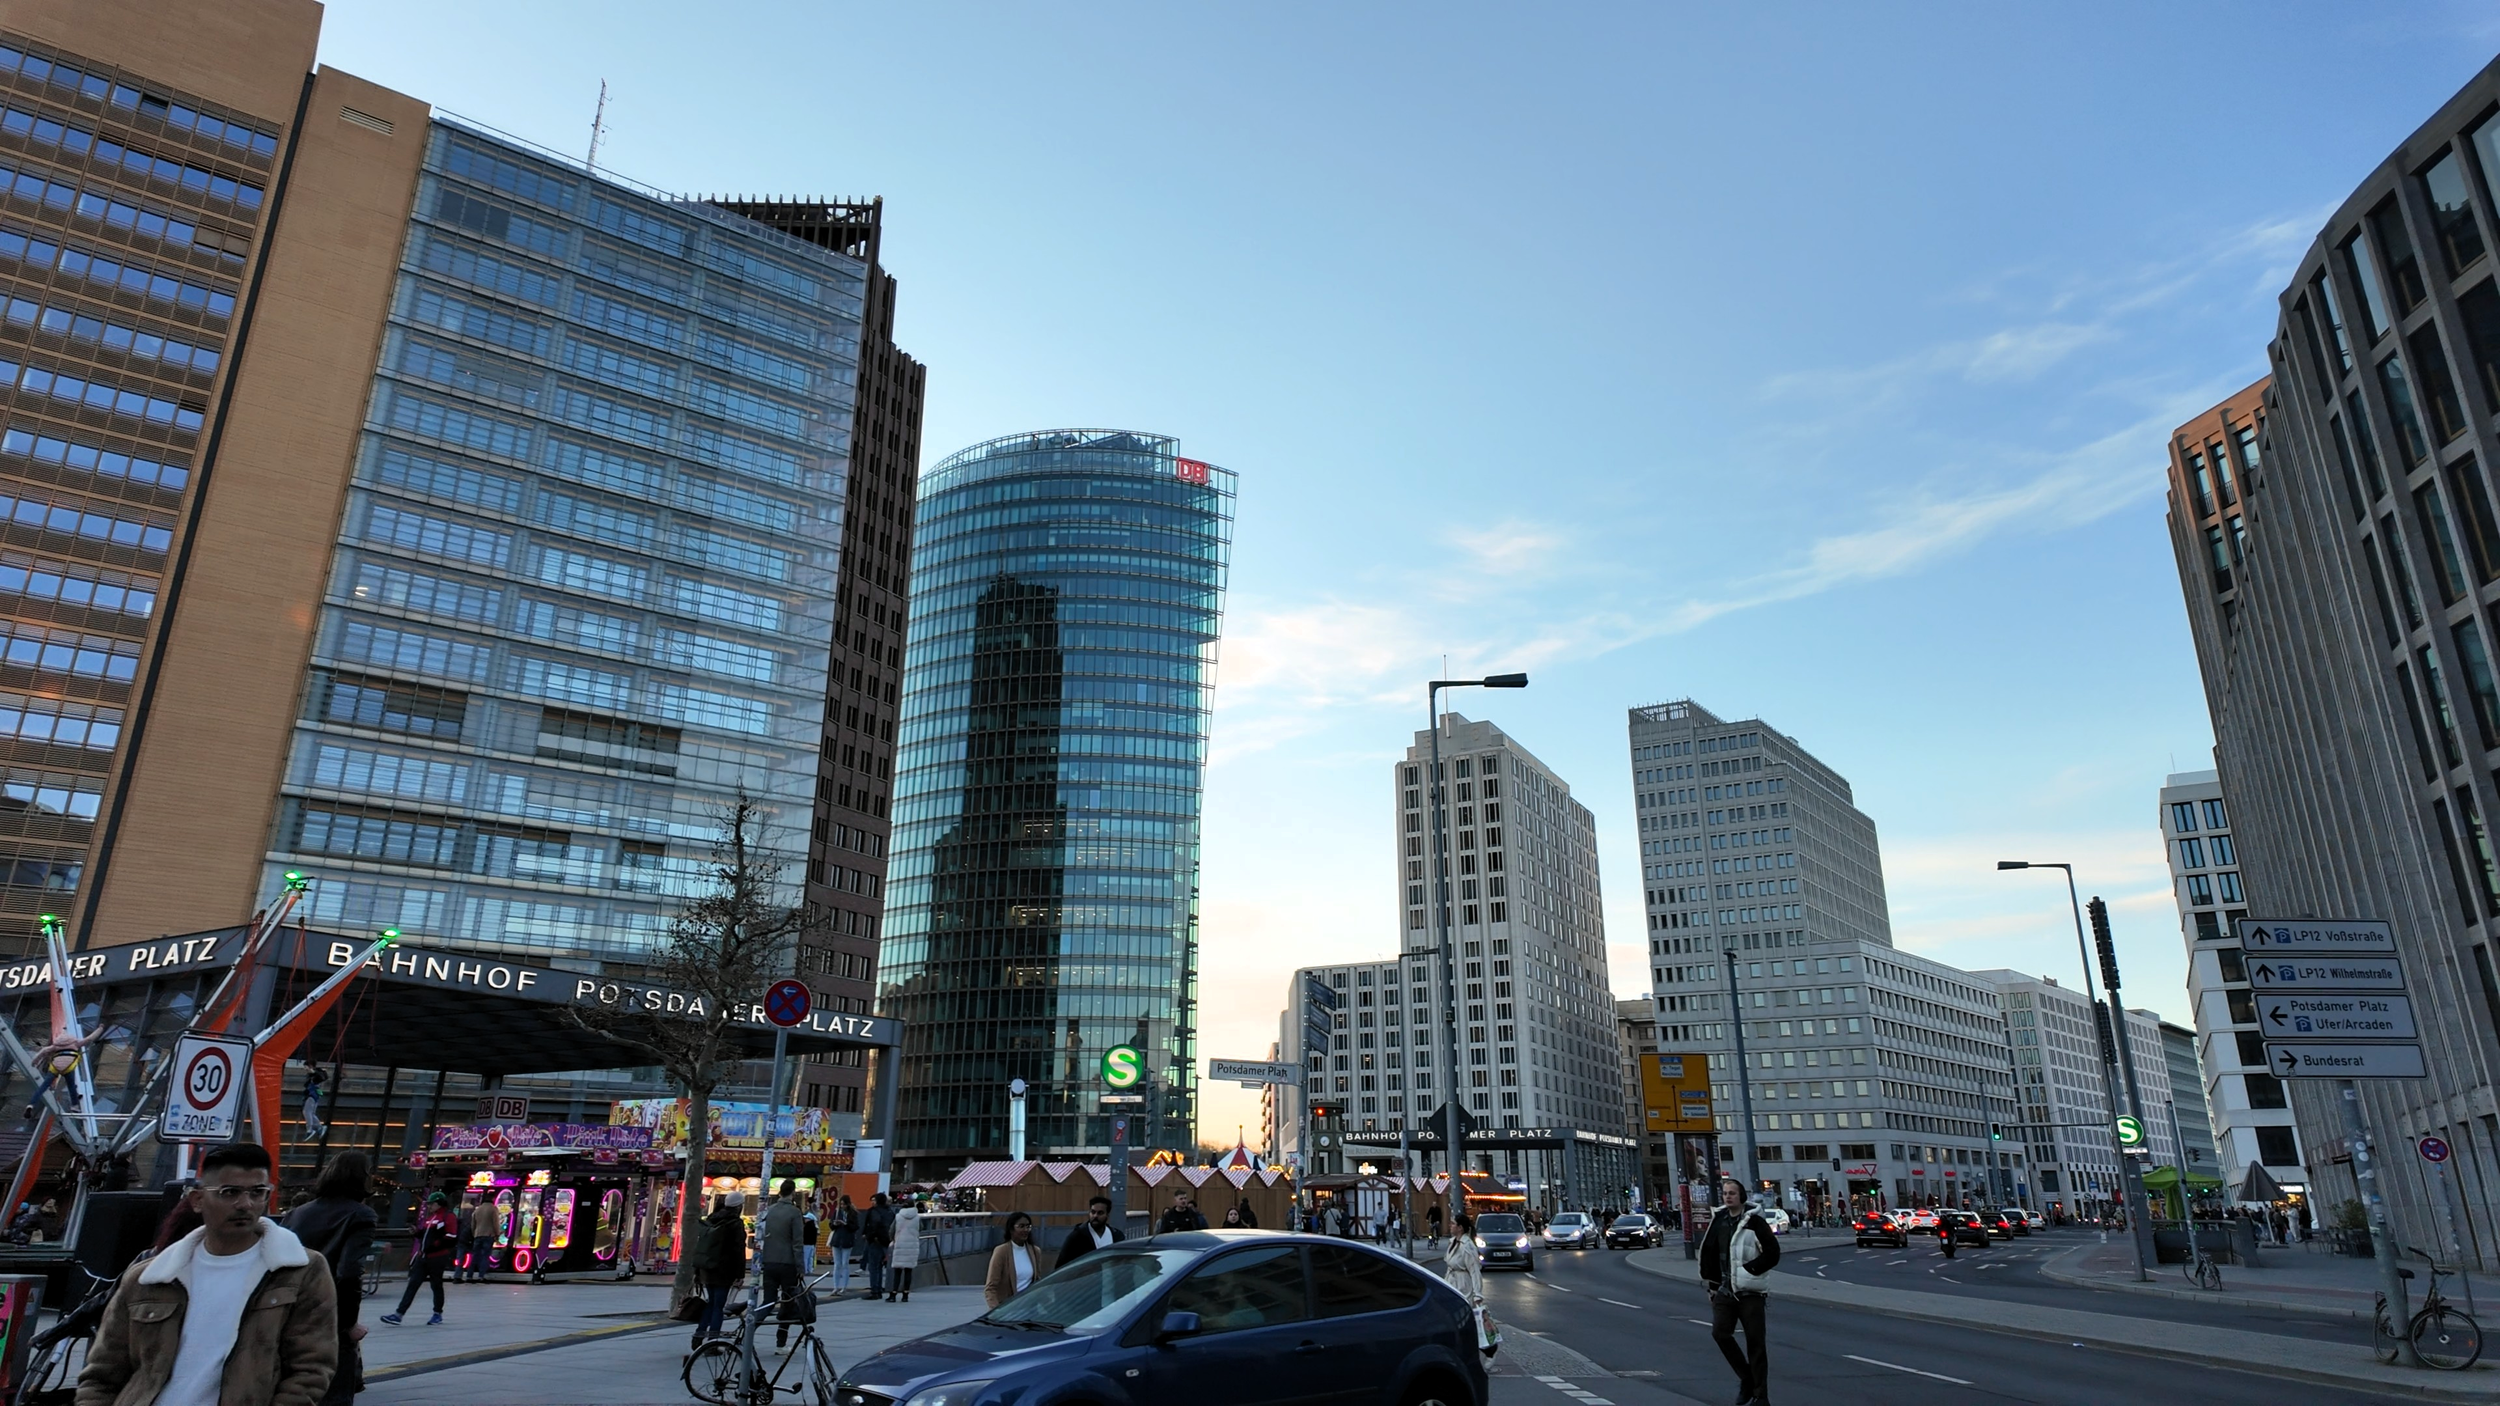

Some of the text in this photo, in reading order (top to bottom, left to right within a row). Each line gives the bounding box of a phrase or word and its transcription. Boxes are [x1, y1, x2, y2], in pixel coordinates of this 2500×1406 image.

[1180, 460, 1205, 483] DB
[2293, 930, 2321, 942] LP12
[2325, 930, 2385, 942] Voßstraße
[0, 937, 219, 989] TSDAER PLATZ
[2298, 968, 2326, 979] LP12
[2329, 968, 2393, 979] Wilhelmstraße
[327, 941, 538, 992] BAHNHOF
[575, 979, 767, 1024] POTSDAER
[2290, 1000, 2390, 1012] Potsdamer Platz
[2315, 1018, 2394, 1030] Ufer/Arcaden
[1108, 1047, 1137, 1086] S
[2303, 1055, 2365, 1067] Bundesrat
[193, 1063, 223, 1094] 30
[1217, 1062, 1288, 1078] Potsdamer Platz
[479, 1099, 523, 1117] DB DB
[181, 1114, 217, 1131] ZONE
[2116, 1118, 2139, 1143] S
[1418, 1130, 1496, 1140] POMER
[1509, 1129, 1552, 1138] PLATZ
